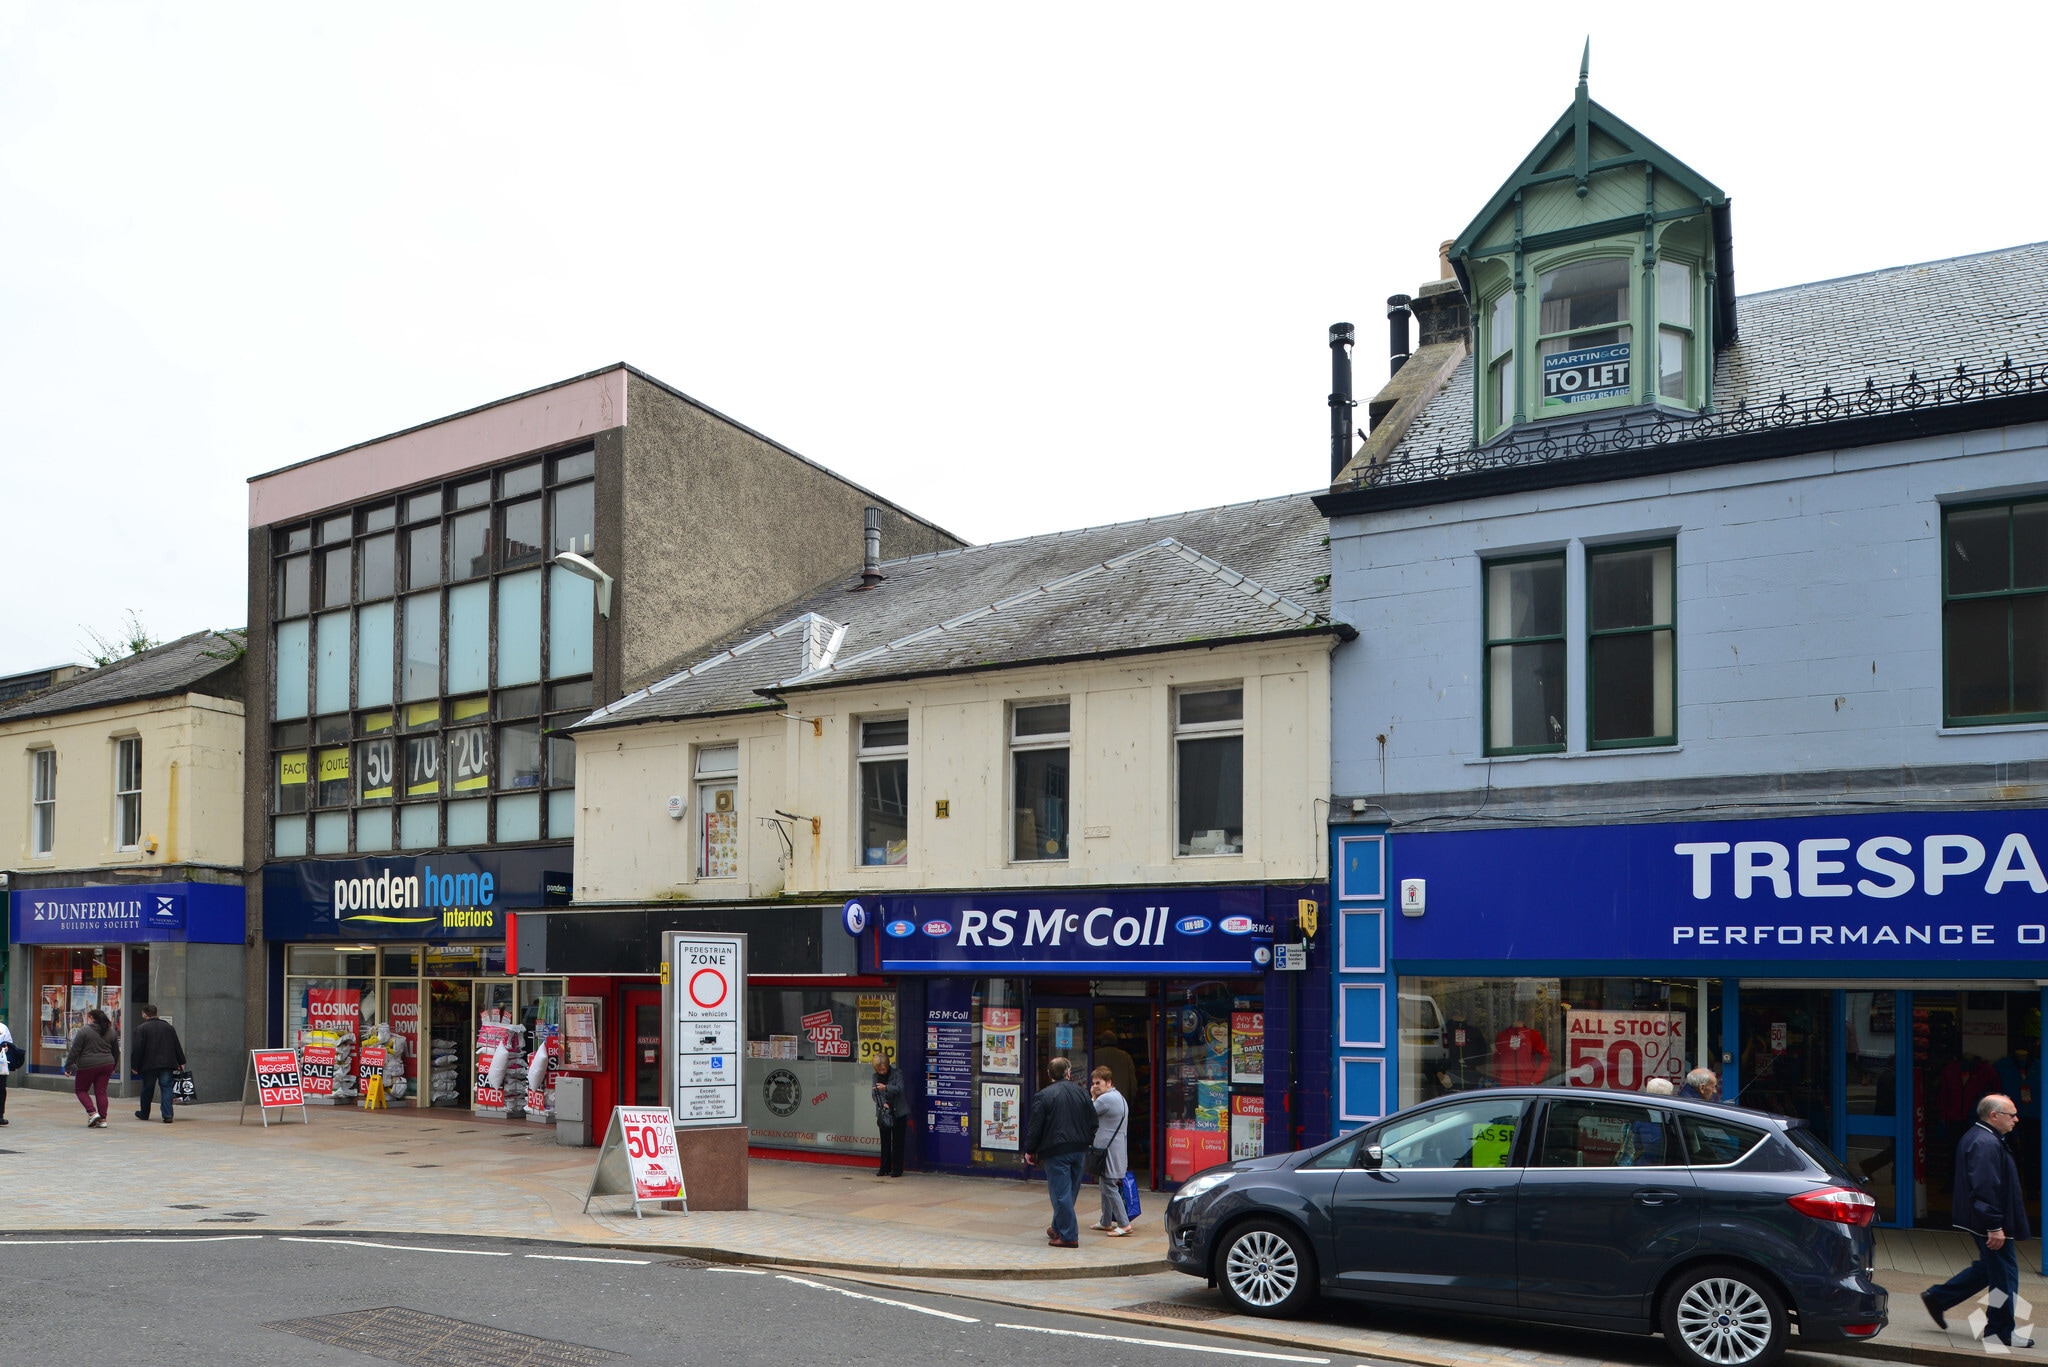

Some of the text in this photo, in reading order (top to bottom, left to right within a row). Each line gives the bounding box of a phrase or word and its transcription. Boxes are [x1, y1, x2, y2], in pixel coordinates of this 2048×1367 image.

[1546, 363, 1628, 393] TO LET
[1674, 832, 2048, 900] TRESPA
[334, 866, 494, 919] ponden home
[546, 884, 566, 893] ponden
[443, 907, 493, 928] interiors
[104, 920, 140, 929] SOCIETY
[956, 909, 1018, 946] RS
[1672, 924, 2046, 945] PERFORMANCE O
[1278, 947, 1285, 955] P
[691, 955, 726, 964] ZONE
[311, 1003, 359, 1016] CLOSING
[929, 1010, 941, 1019] RS
[992, 1011, 1009, 1026] £1
[1237, 1015, 1251, 1023] Any
[315, 1020, 353, 1032] DOWN
[1570, 1018, 1682, 1037] ALL STOCK
[810, 1027, 840, 1040] JUST
[817, 1041, 840, 1054] EAT
[862, 1042, 895, 1058] 99p
[304, 1056, 333, 1064] BIGGEST
[361, 1056, 383, 1066] BIGGEST
[1570, 1038, 1682, 1092] 50%
[259, 1064, 296, 1073] BIGGEST
[304, 1064, 333, 1078] SALE
[261, 1073, 298, 1088] SALE
[303, 1077, 331, 1090] EVER
[263, 1088, 300, 1102] EVER
[478, 1088, 503, 1103] EVER
[528, 1091, 543, 1106] EVER
[812, 1091, 828, 1106] OPEN
[1243, 1105, 1264, 1113] offer
[624, 1114, 669, 1124] ALL STOCK
[751, 1129, 815, 1140] CHICKEN COTTAGE
[826, 1134, 858, 1143] CHICKEN
[625, 1126, 672, 1158] 50%
[660, 1146, 673, 1154] OFF
